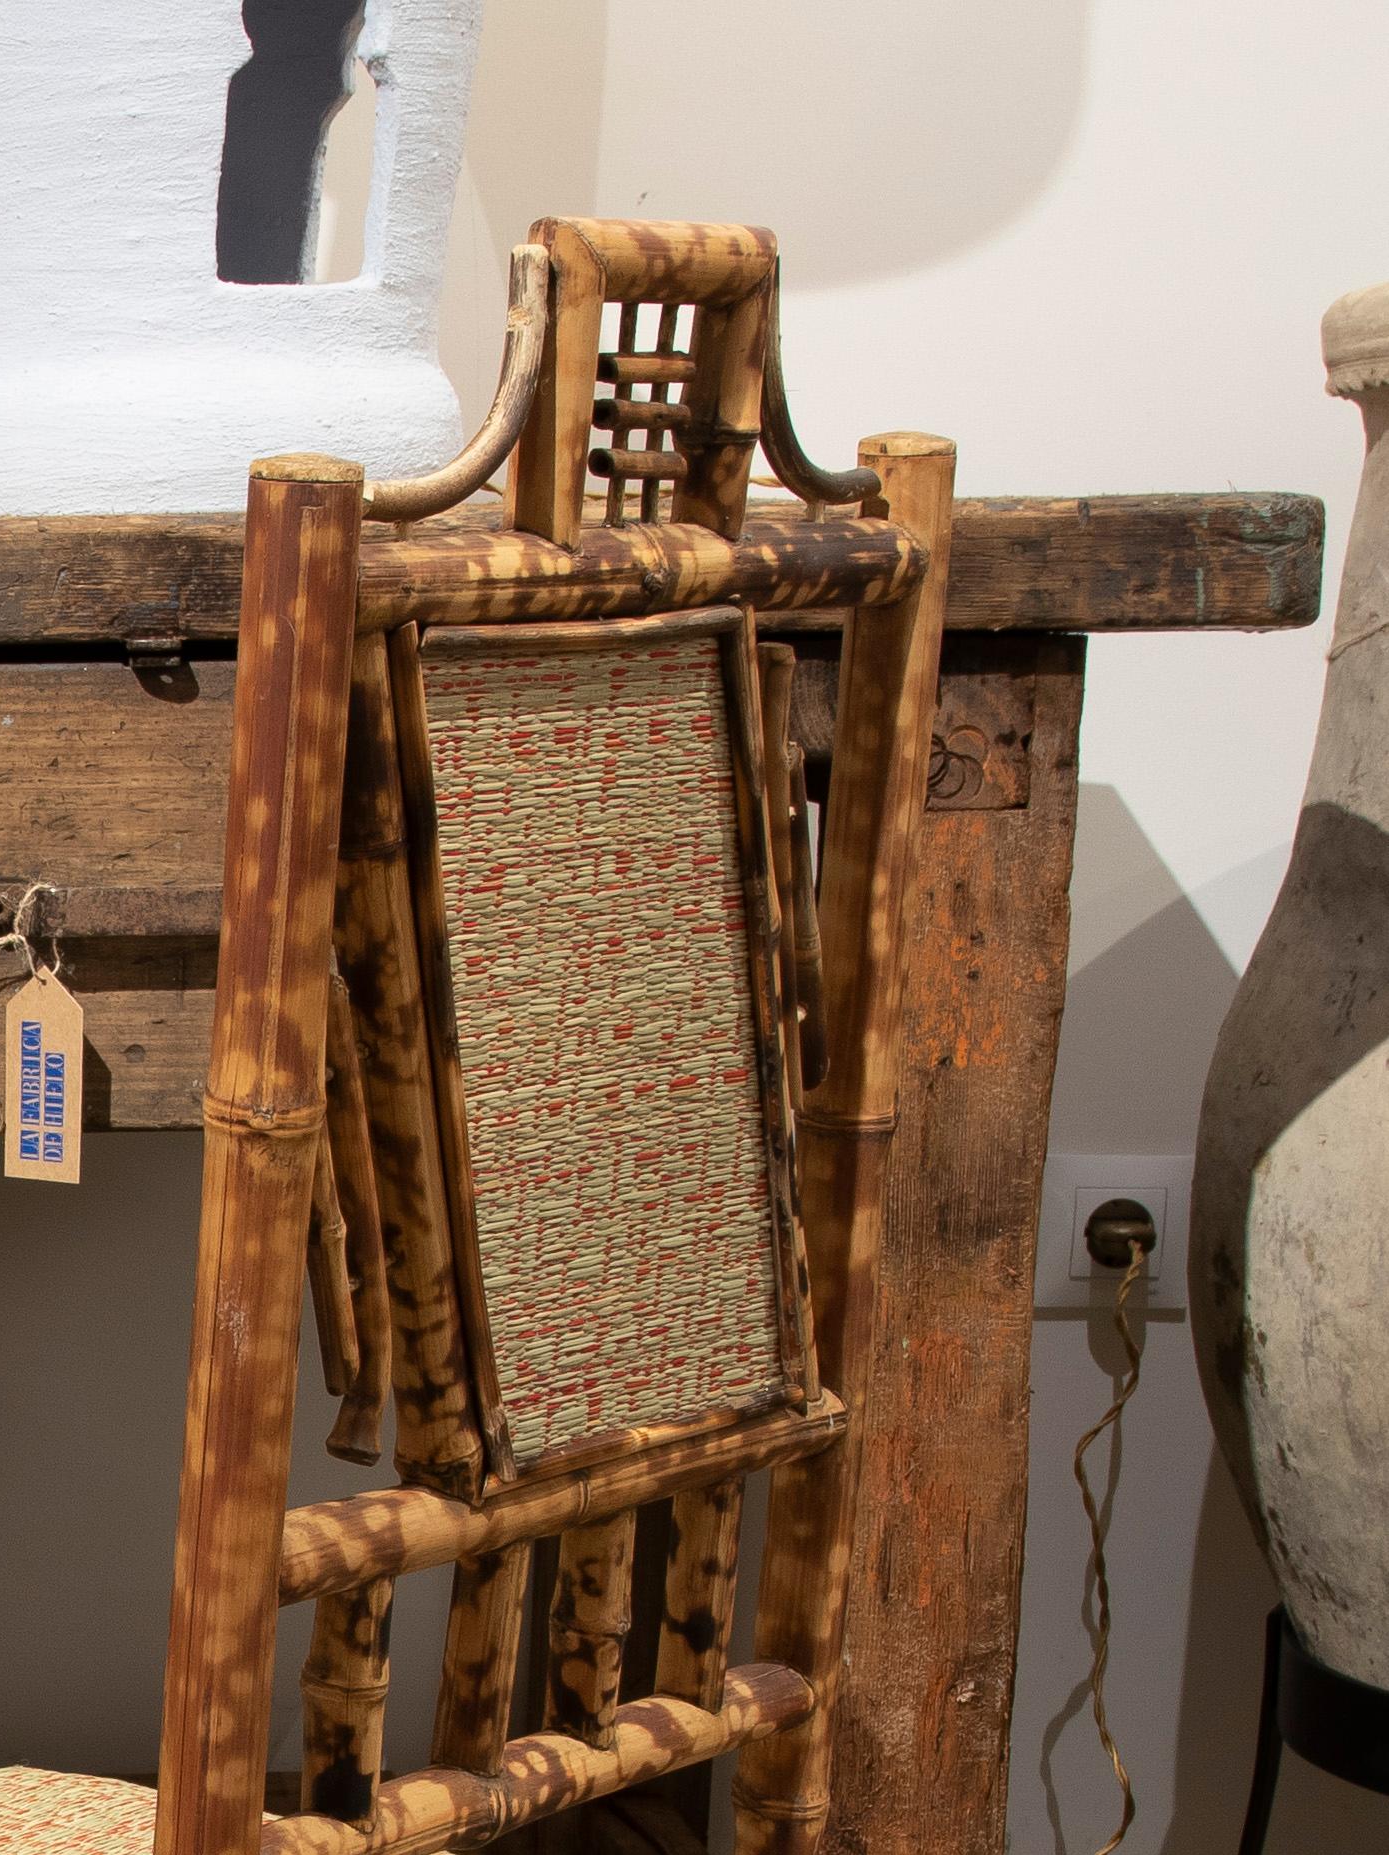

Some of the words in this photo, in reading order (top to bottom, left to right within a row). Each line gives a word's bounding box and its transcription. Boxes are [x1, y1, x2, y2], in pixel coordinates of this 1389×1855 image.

[21, 1021, 41, 1124] FABRICA
[44, 1053, 64, 1126] HIELO
[20, 1130, 39, 1160] LA
[44, 1132, 63, 1162] DE
